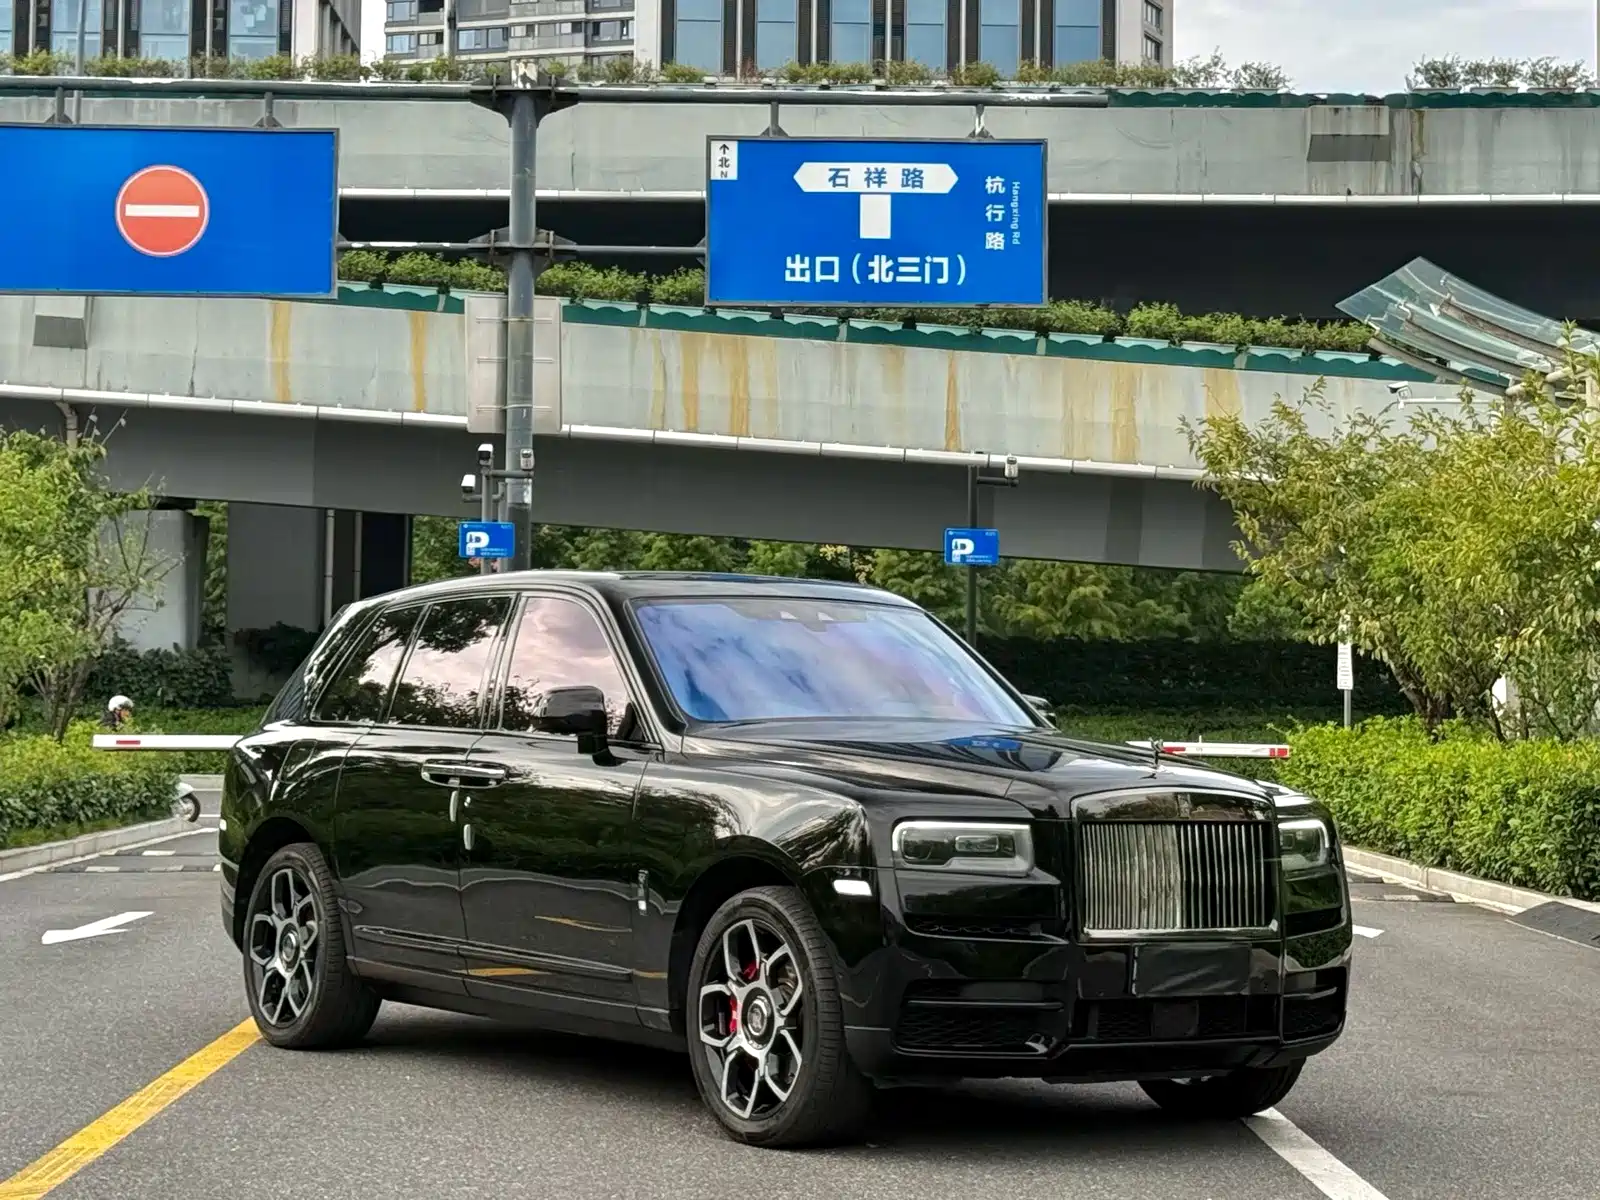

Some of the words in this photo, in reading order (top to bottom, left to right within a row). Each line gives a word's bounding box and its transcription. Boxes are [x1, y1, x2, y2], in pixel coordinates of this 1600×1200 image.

[718, 156, 730, 168] 北
[720, 170, 728, 178] N
[828, 167, 924, 189] 石祥路
[985, 176, 1005, 250] 杭行路
[1010, 181, 1021, 229] Hangxing
[1012, 231, 1021, 245] Rd
[785, 253, 966, 285] 出口（北三门）
